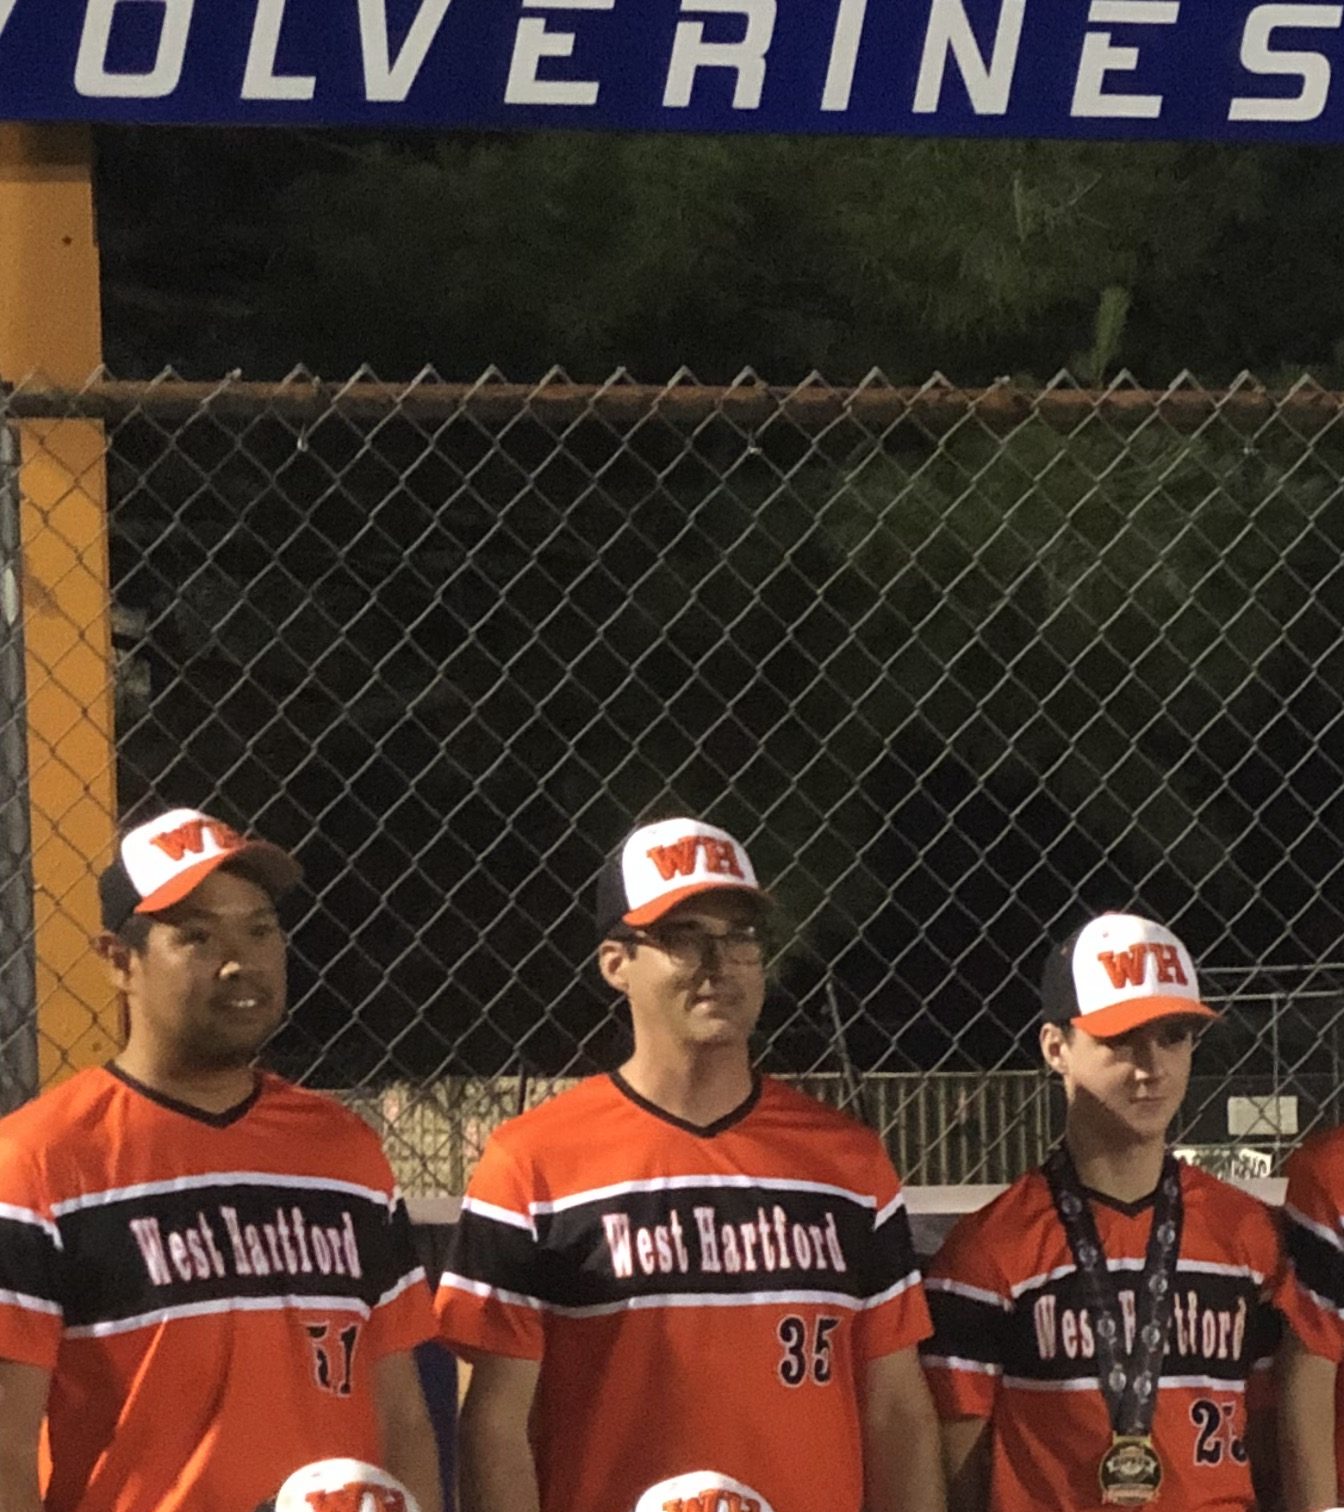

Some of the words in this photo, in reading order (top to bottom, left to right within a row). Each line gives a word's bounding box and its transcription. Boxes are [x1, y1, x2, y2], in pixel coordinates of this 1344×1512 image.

[0, 0, 1343, 121] OLVERINES
[647, 835, 745, 881] WH
[1097, 942, 1189, 989] WH
[602, 1209, 689, 1278] West
[693, 1205, 847, 1273] Hartford
[776, 1313, 844, 1388] 35
[1034, 1294, 1096, 1360] Wes
